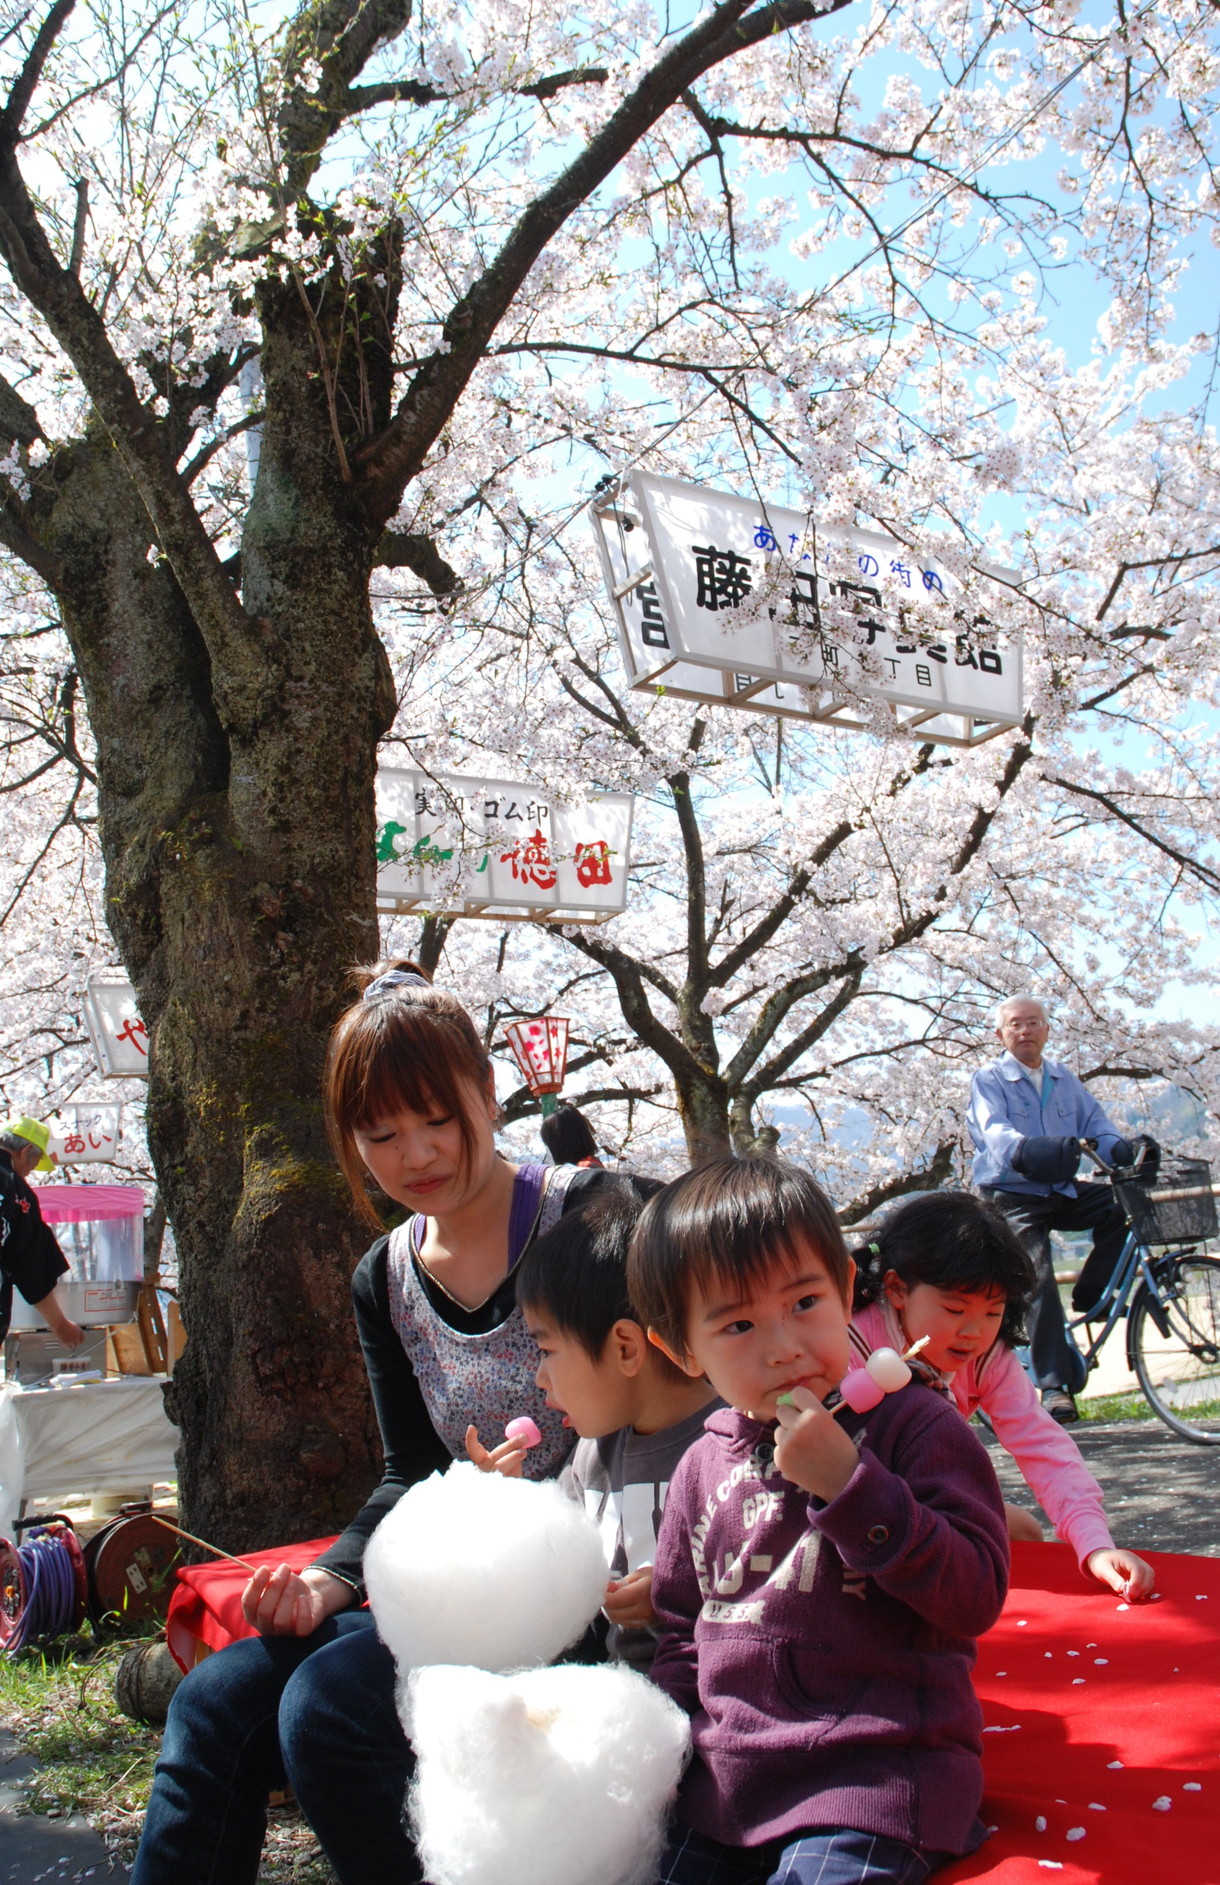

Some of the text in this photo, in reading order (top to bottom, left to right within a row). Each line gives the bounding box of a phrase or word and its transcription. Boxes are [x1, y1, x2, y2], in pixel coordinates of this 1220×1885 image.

[59, 1114, 102, 1131] スナック
[64, 1132, 112, 1154] あい
